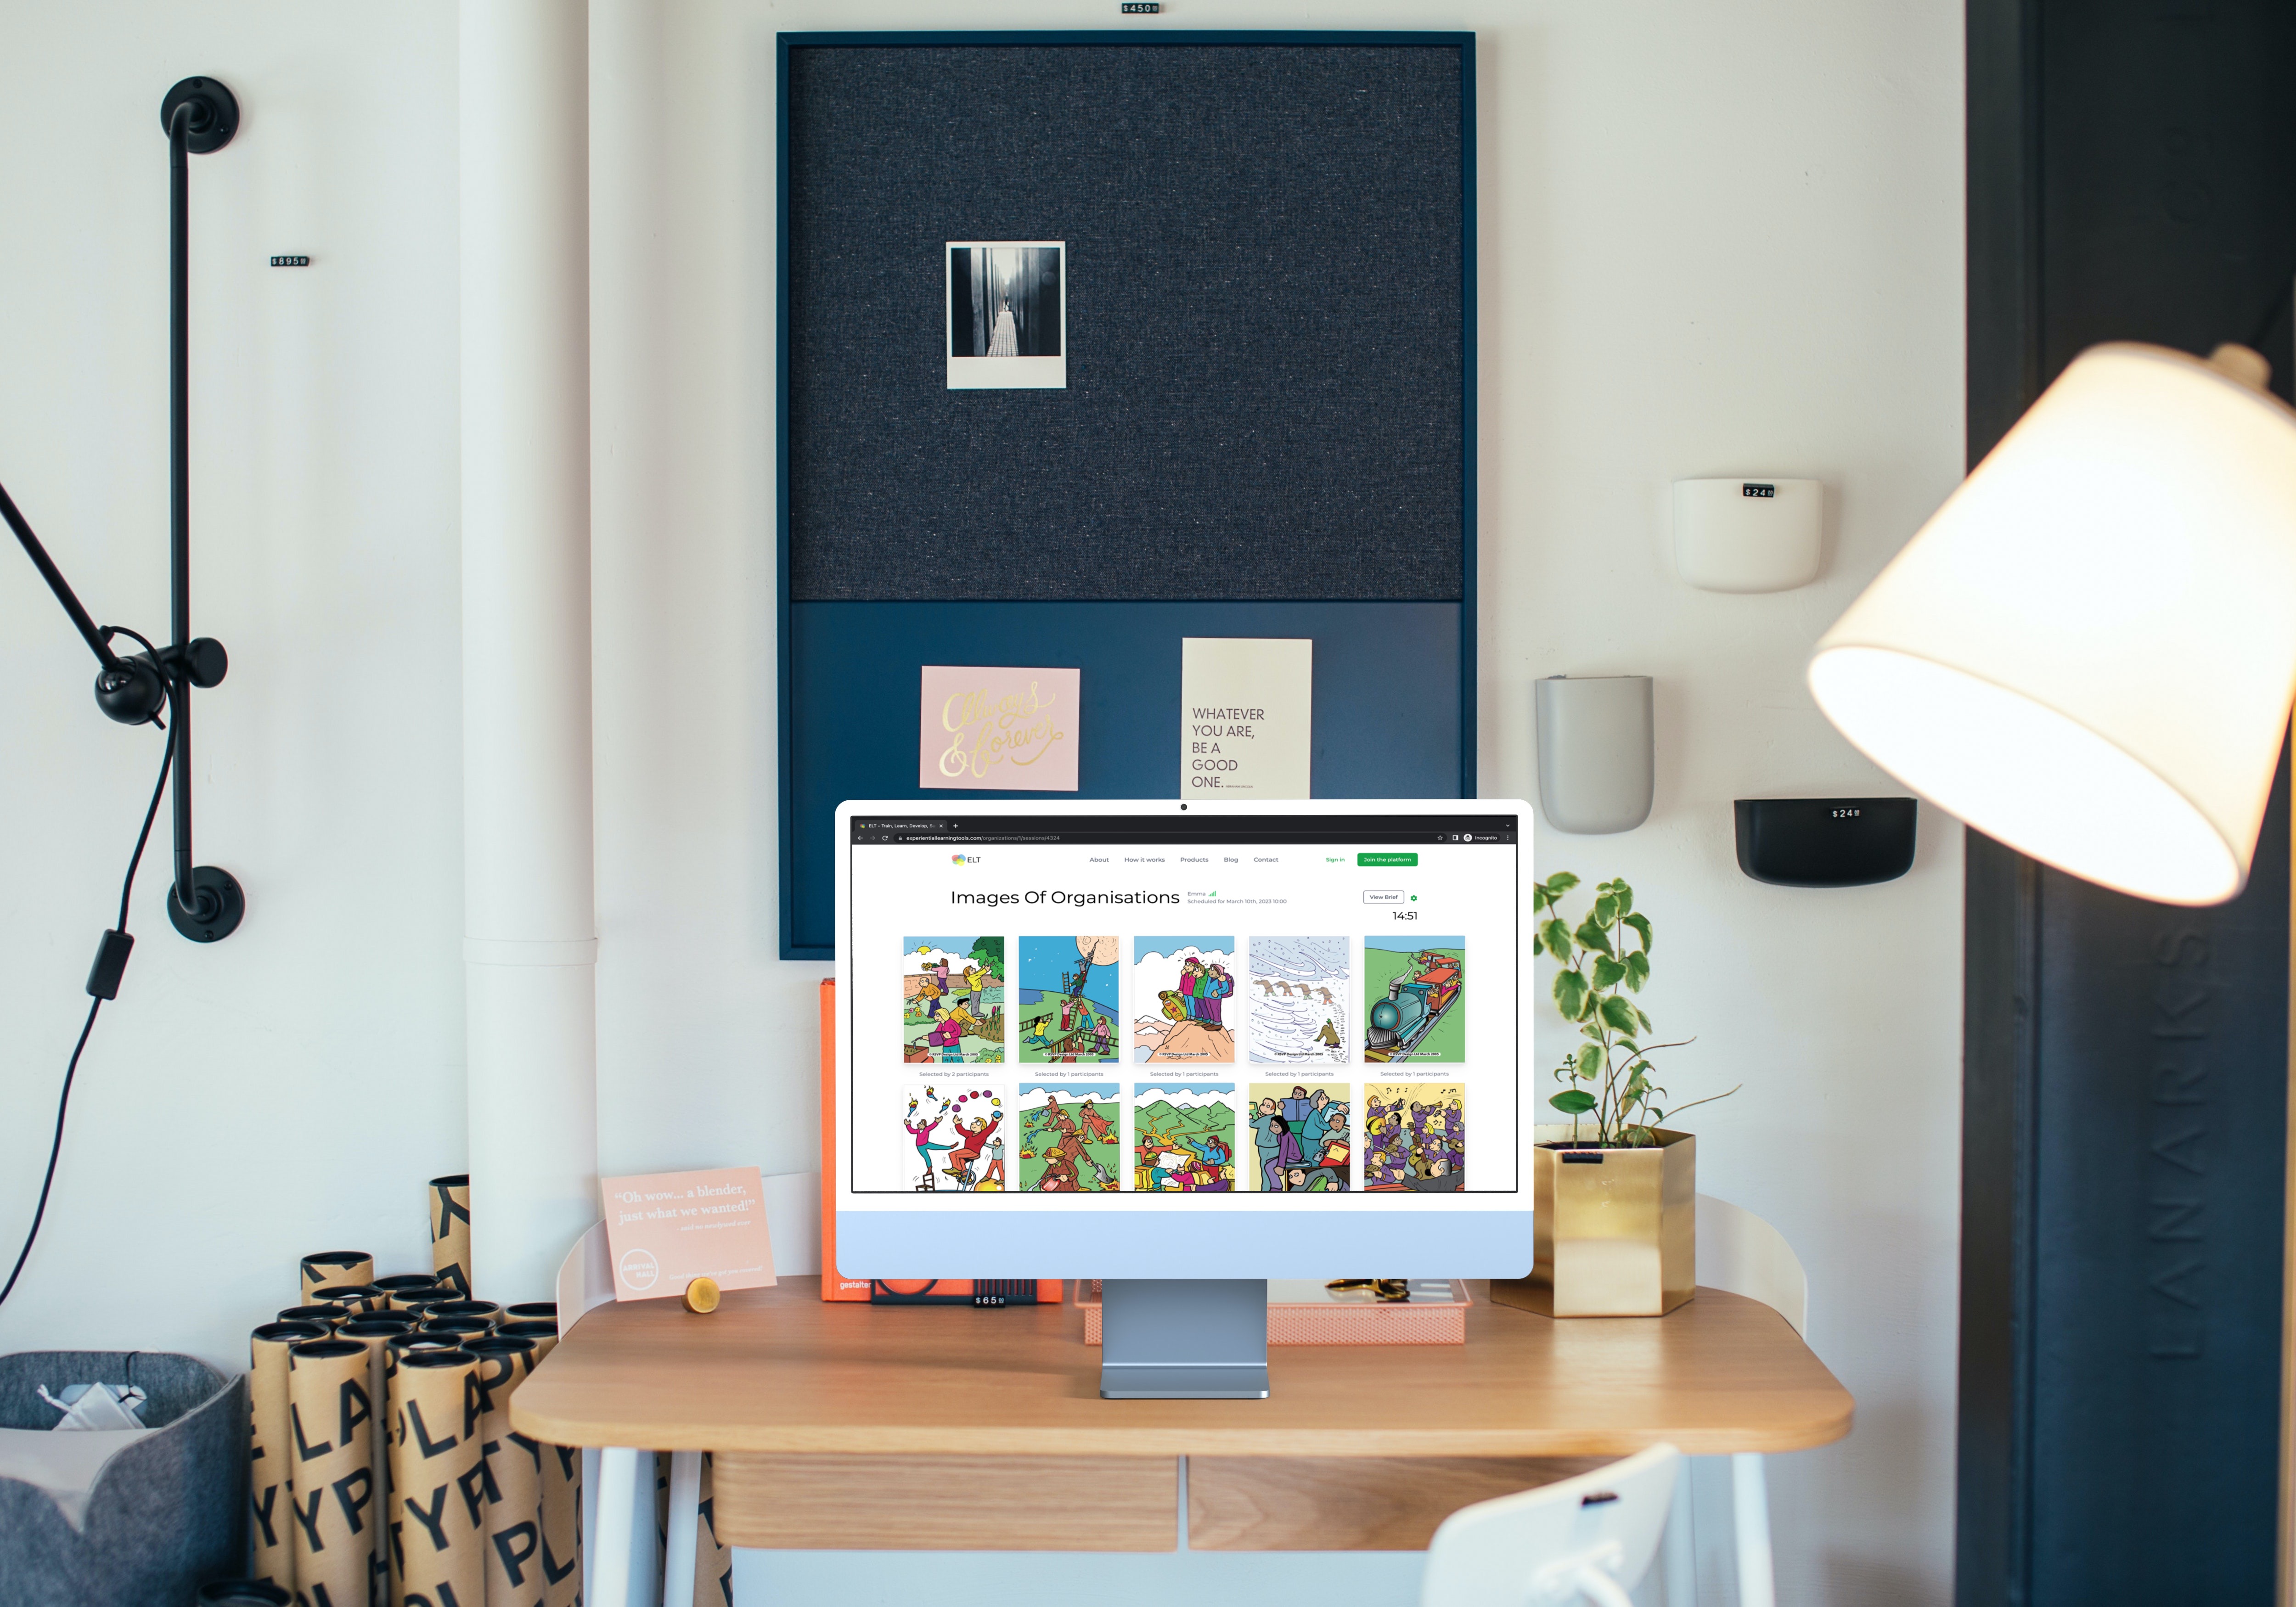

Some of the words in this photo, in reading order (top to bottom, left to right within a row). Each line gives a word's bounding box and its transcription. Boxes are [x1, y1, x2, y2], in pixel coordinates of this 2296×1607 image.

[1193, 708, 1265, 720] WHATEVER
[1192, 725, 1222, 736] YOU
[1226, 725, 1255, 739] ARE,
[1193, 742, 1207, 753] BE
[1211, 742, 1221, 753] A
[1192, 759, 1238, 771] GOOD
[1192, 776, 1224, 788] ONE.
[952, 891, 1019, 907] Images
[1024, 890, 1047, 904] Of
[1051, 890, 1180, 907] Organisations
[1392, 911, 1417, 920] 14:51
[687, 1189, 695, 1198] a
[696, 1183, 747, 1197] blender,
[618, 1210, 643, 1226] just
[646, 1207, 678, 1220] what
[680, 1207, 698, 1217] we
[636, 1270, 655, 1278] HALL
